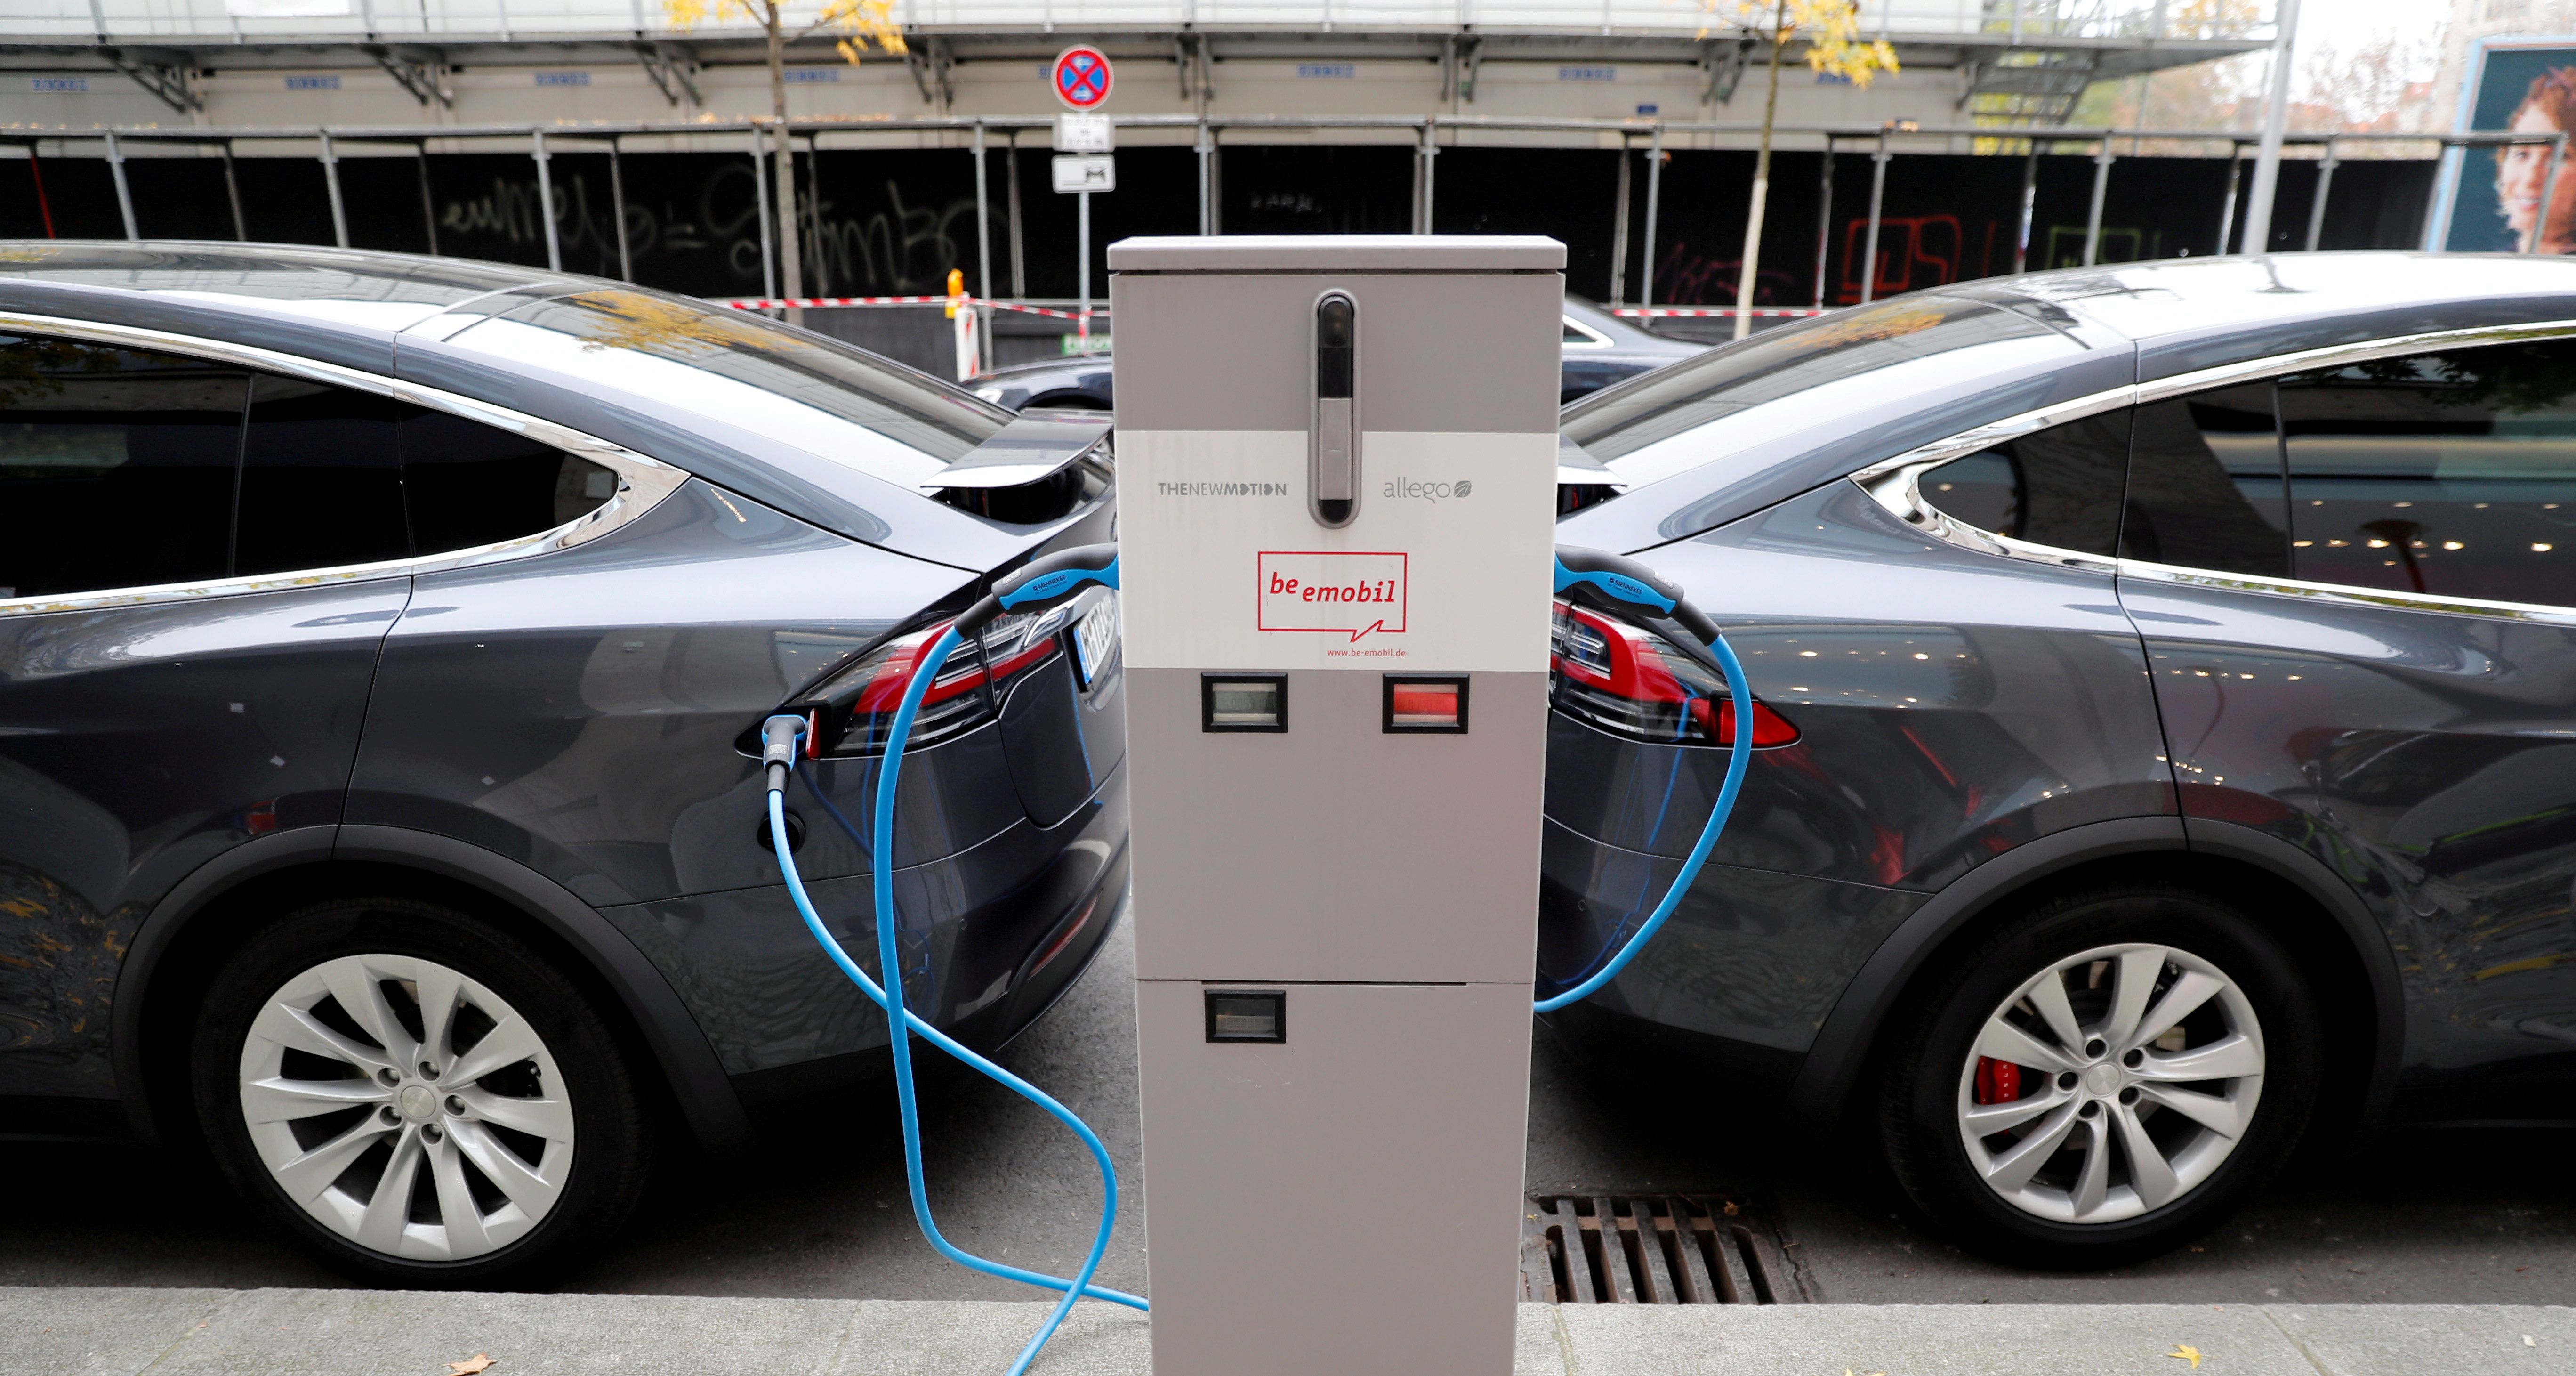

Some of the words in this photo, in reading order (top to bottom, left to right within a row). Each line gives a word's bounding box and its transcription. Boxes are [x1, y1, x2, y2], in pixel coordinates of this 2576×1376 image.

[1383, 477, 1451, 504] allego
[1038, 575, 1066, 590] MENNEKES
[1270, 572, 1298, 594] be
[1302, 580, 1395, 603] emobil
[1615, 579, 1642, 595] MENNEKES
[1327, 648, 1406, 657] www.be-emobil.de
